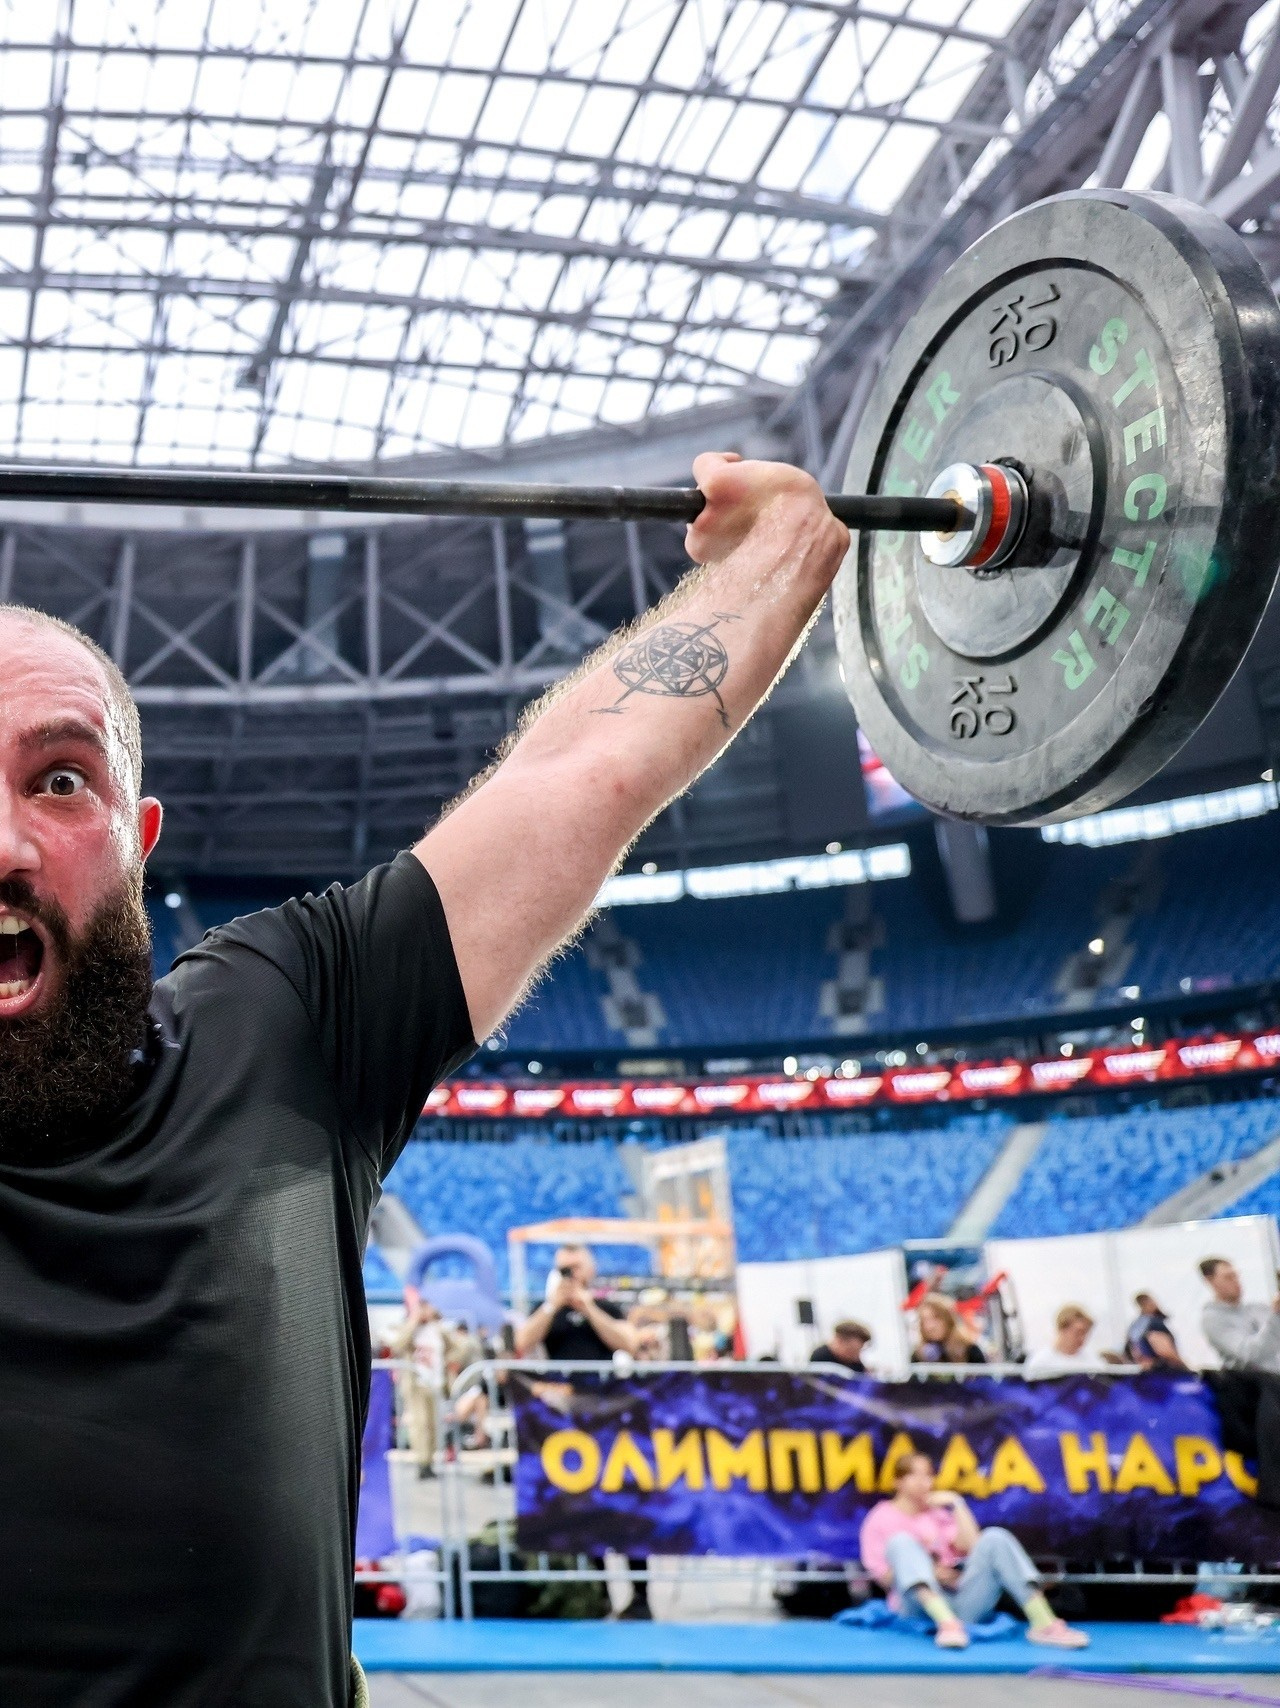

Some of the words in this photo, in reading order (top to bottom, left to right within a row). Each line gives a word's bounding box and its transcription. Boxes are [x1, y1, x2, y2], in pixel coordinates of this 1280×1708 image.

[988, 295, 1023, 369] KG
[1023, 283, 1061, 352] 10
[1051, 317, 1168, 690] STECTER
[949, 674, 983, 740] KG
[983, 674, 1019, 736] 10
[540, 1429, 1047, 1499] ОЛИМПИАДА
